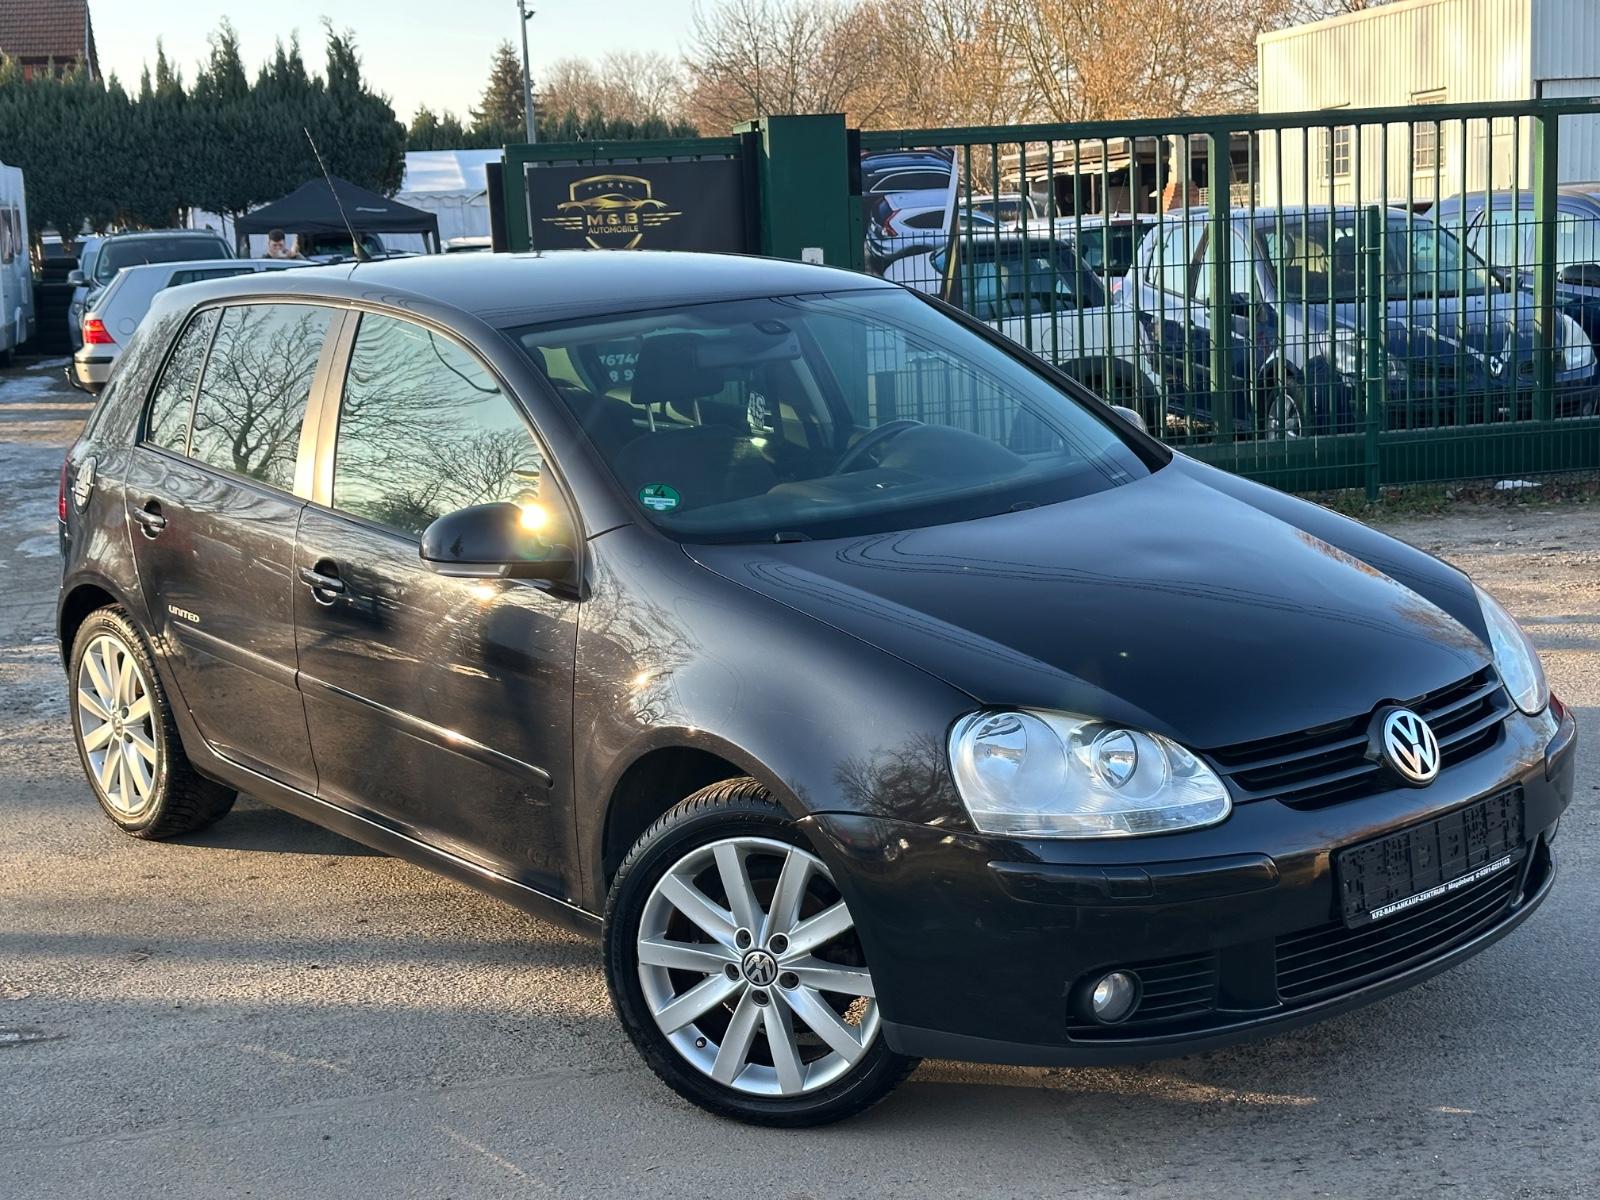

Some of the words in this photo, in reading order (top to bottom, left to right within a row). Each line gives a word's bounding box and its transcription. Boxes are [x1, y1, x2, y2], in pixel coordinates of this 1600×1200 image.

[586, 214, 603, 226] M
[625, 212, 639, 224] B
[588, 225, 639, 234] AUTOMOBILE
[168, 604, 200, 623] UNITED
